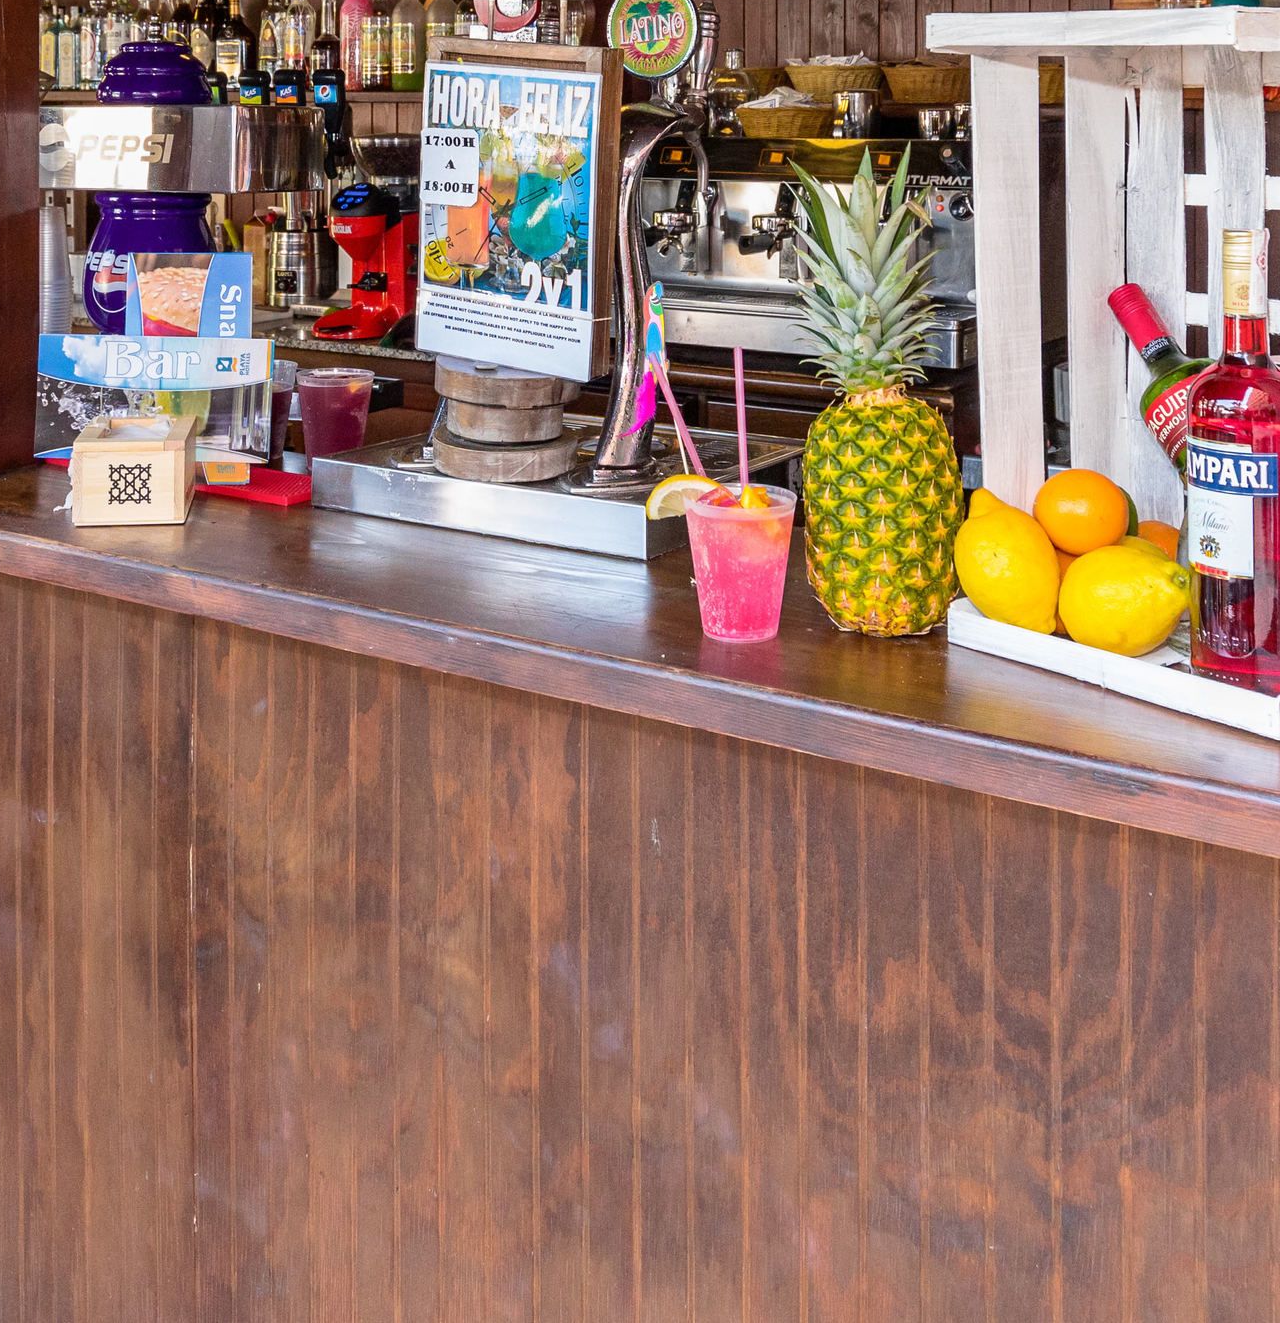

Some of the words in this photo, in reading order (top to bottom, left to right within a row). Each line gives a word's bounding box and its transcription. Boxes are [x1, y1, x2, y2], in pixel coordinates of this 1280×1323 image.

[619, 12, 685, 45] LATINO
[244, 87, 257, 97] KAS
[280, 86, 293, 96] KAS
[432, 74, 501, 128] HORA
[520, 81, 592, 139] FELIZ
[77, 133, 175, 164] PEPSI
[444, 159, 456, 170] A
[86, 250, 129, 274] PEPS
[220, 284, 243, 337] Sna
[104, 341, 201, 380] Bar
[1147, 384, 1192, 437] AGUIR
[1158, 408, 1188, 443] VERMOU
[1187, 449, 1274, 490] AMPARI.
